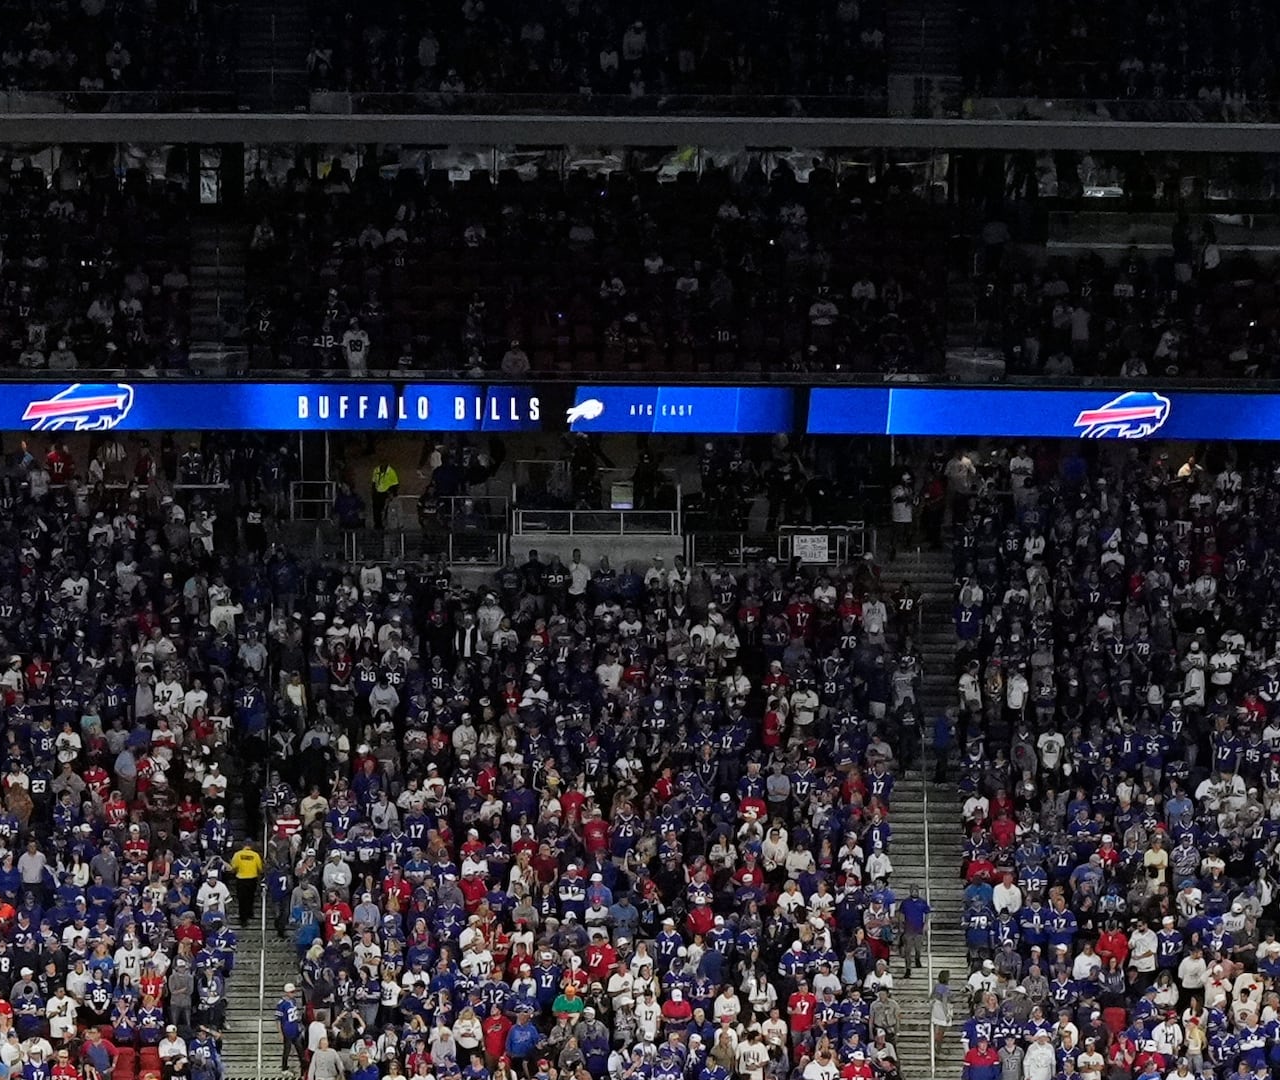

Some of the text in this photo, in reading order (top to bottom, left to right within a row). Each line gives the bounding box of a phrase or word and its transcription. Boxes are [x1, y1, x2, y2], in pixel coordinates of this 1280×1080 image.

[298, 396, 540, 420] BUFFALO BILLS
[630, 405, 693, 416] AFC EAST
[1269, 681, 1279, 693] 17
[722, 735, 733, 749] 17
[1218, 747, 1231, 760] 17
[32, 780, 46, 793] 23
[797, 782, 809, 794] 17
[873, 782, 884, 794] 17
[338, 817, 349, 829] 17
[410, 824, 424, 838] 17
[1027, 879, 1040, 891] 12
[541, 975, 553, 987] 17
[93, 989, 106, 1002] 86
[490, 989, 504, 1003] 12
[645, 1011, 654, 1021] 17
